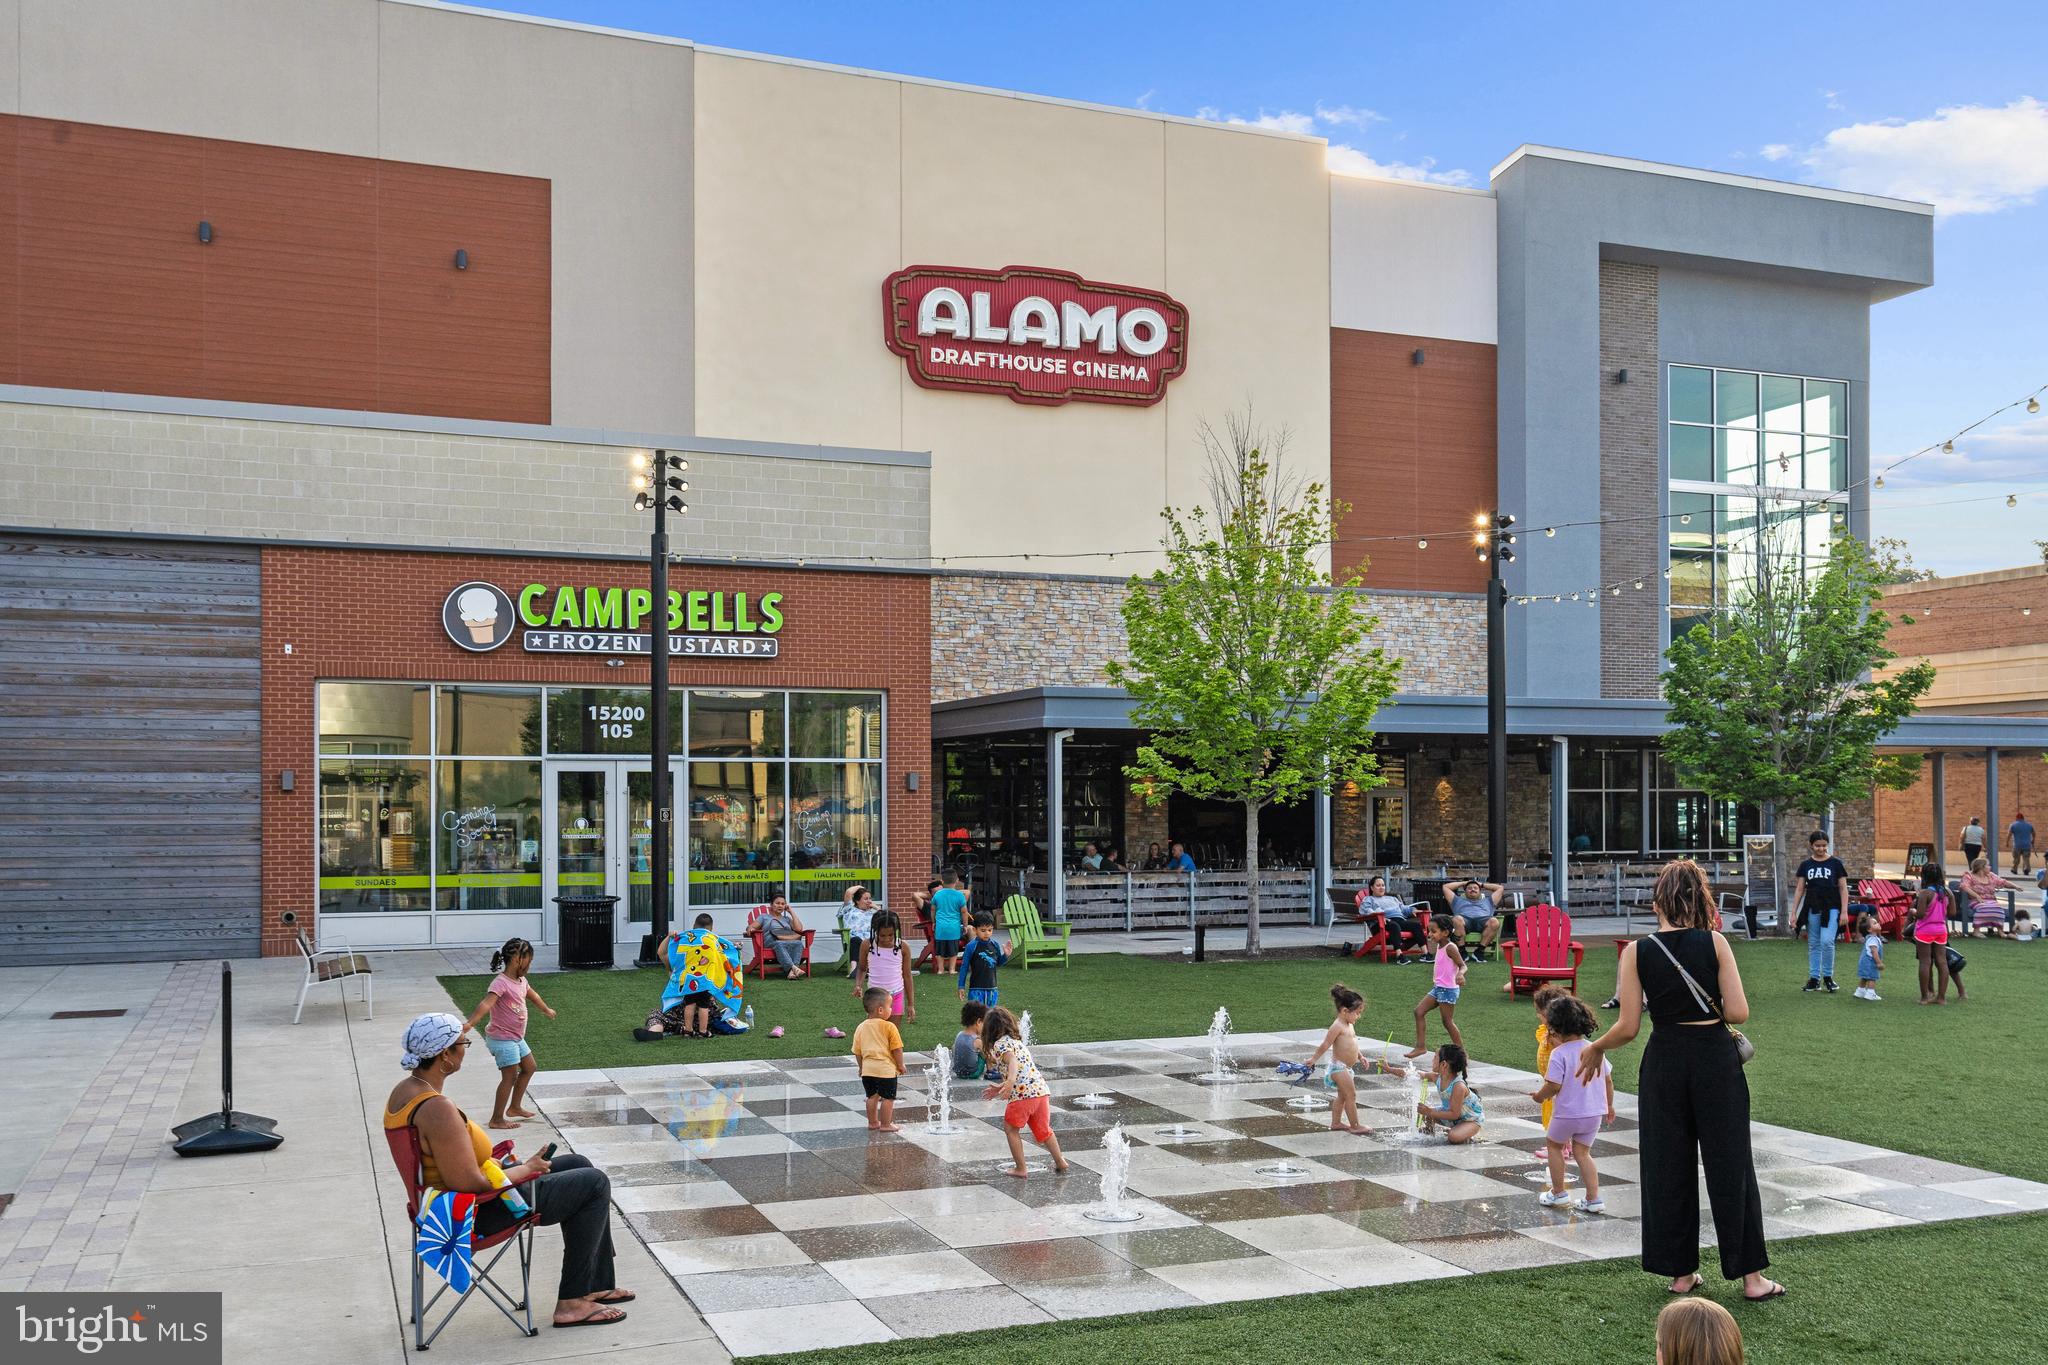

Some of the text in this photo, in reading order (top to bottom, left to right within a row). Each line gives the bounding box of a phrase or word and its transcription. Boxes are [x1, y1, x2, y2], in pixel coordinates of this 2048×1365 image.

[918, 287, 1168, 357] ALAMO
[930, 347, 1150, 382] DRAFTHOUSE CINEMA
[518, 583, 784, 633] CAMPBELLS
[549, 634, 756, 654] FROZEN USTARD
[588, 705, 645, 721] 15200
[600, 723, 633, 738] 105
[442, 803, 496, 830] Coming
[704, 873, 735, 881] SHAKES
[745, 872, 769, 880] MALTS
[814, 871, 842, 879] ITALIAN
[1807, 867, 1831, 880] GAP
[355, 878, 397, 886] SUNDAES
